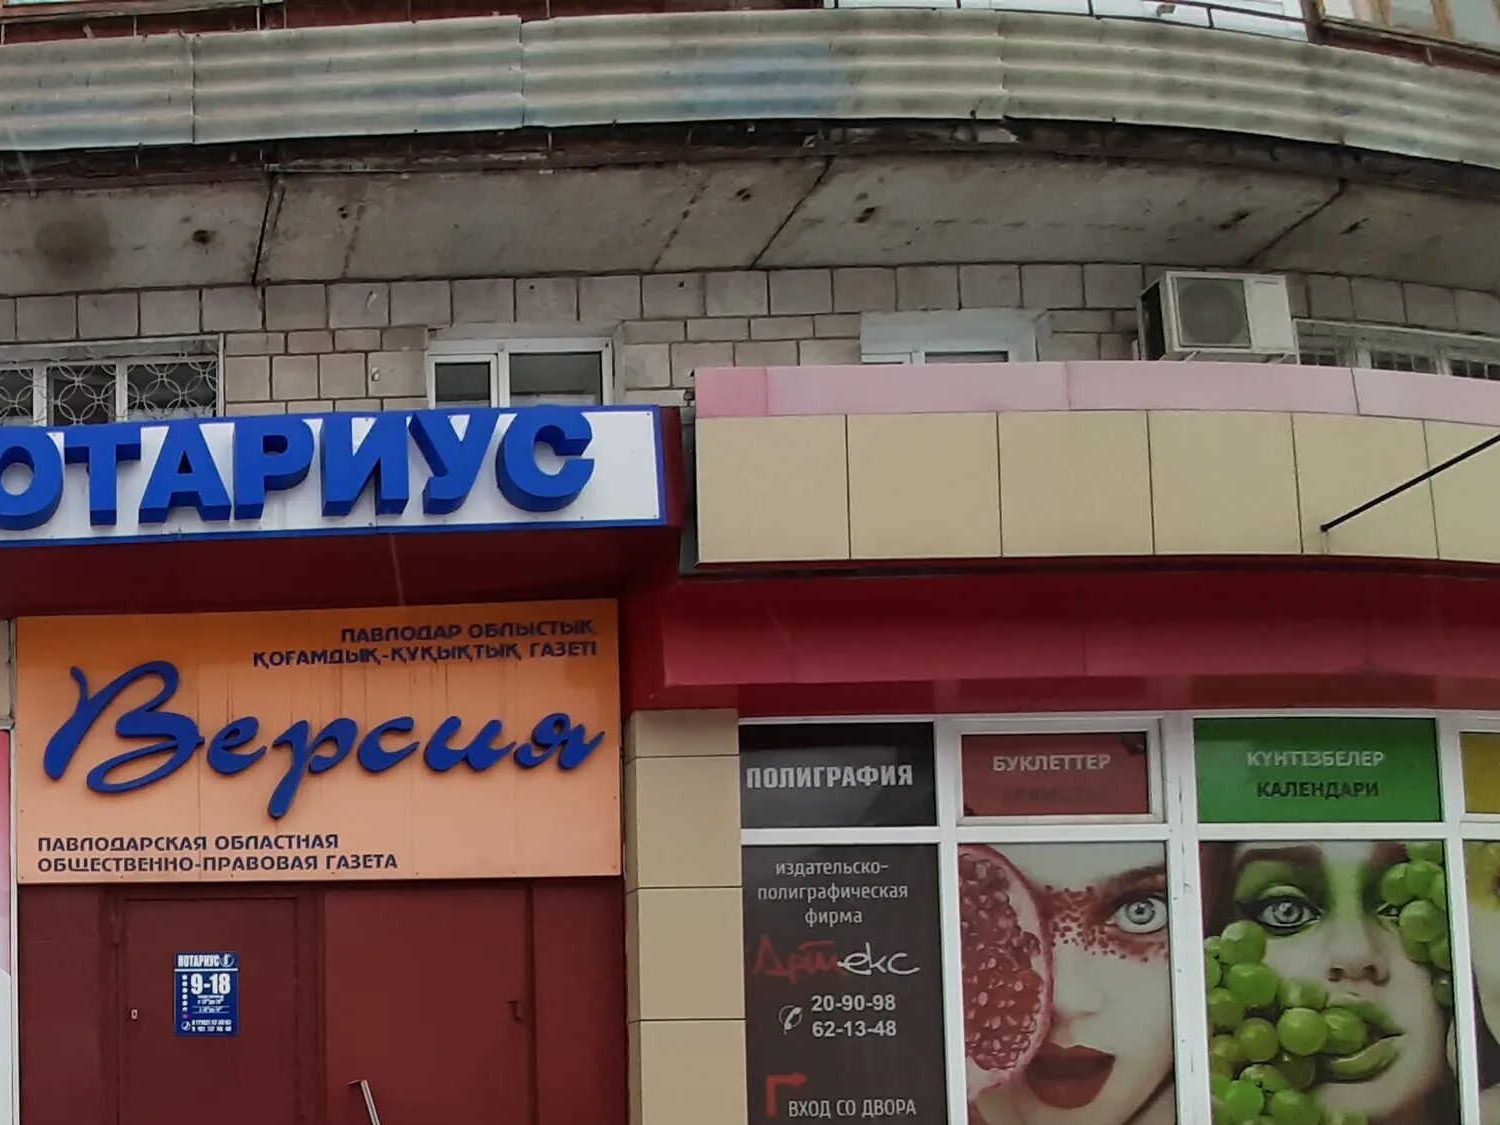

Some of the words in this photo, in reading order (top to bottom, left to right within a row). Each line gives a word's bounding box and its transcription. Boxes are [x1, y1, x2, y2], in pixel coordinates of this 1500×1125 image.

[341, 623, 463, 642] ПАВЛОДАР
[530, 641, 597, 658] ГАЗЕТІ
[43, 660, 606, 819] Версия
[993, 754, 1111, 771] БУКЛЕТТЕР
[746, 765, 913, 788] ПОЛИГРАФИЯ
[1257, 781, 1379, 800] КАЛЕНДАРИ
[38, 835, 208, 851] ПАВЛОДАРСКАЯ
[215, 833, 339, 850] ОБЛАСТНАЯ
[38, 855, 318, 873] ОБЩЕСТВЕННО-ПРАВОВАЯ
[326, 853, 398, 870] ГАЗЕТА
[775, 860, 889, 876] издательско-
[757, 883, 908, 903] полиграфическая
[804, 908, 863, 927] фирма
[190, 973, 231, 995] 9-18
[811, 994, 896, 1012] 20-90-98
[812, 1020, 897, 1037] 62-13-48
[788, 1101, 831, 1119] ВХОД
[836, 1100, 856, 1117] СО
[861, 1099, 917, 1119] ДВОРА
